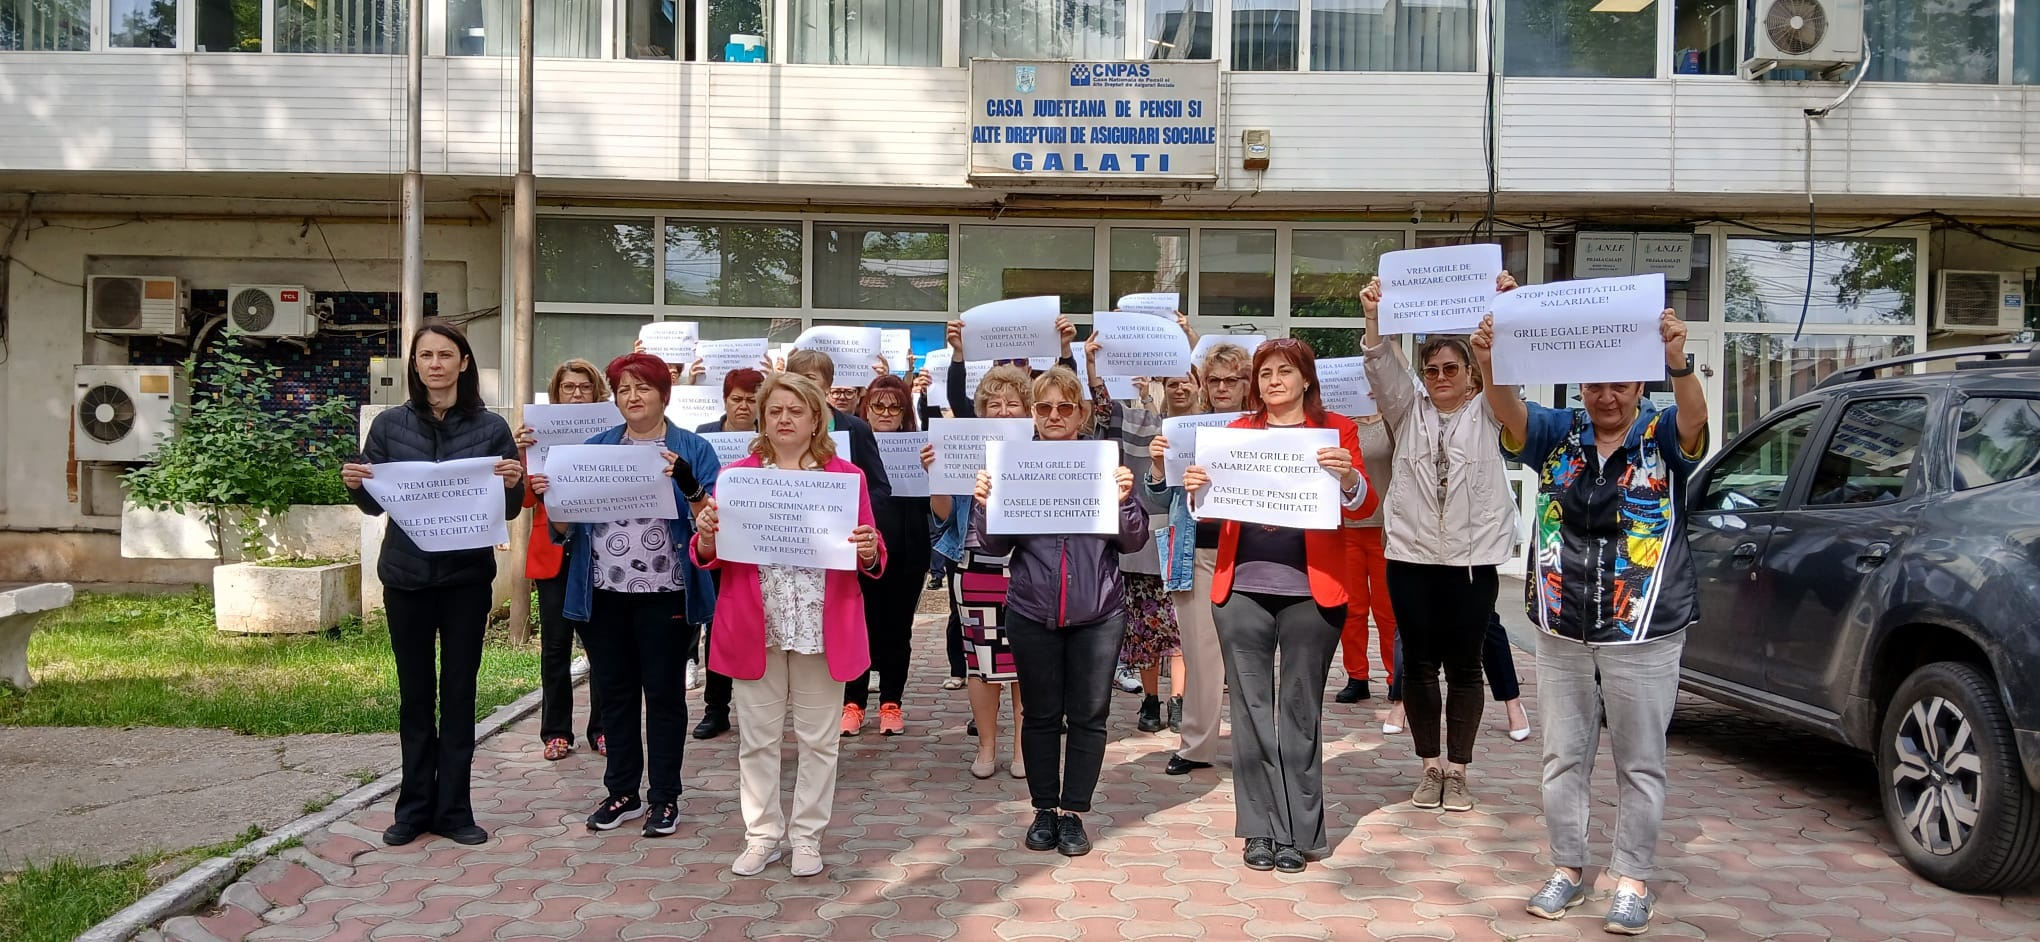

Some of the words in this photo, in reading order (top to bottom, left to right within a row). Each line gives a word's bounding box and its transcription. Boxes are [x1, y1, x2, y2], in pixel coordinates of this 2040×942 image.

[1093, 64, 1150, 76] CNPAS
[986, 99, 1024, 118] CASA
[1033, 99, 1106, 118] JUDETEANA
[1116, 100, 1132, 118] DE
[1140, 100, 1182, 118] PENSII
[1188, 100, 1202, 118] SI
[972, 126, 1001, 144] ALTE
[1006, 127, 1066, 144] DREPTURI
[1070, 127, 1086, 144] DE
[1090, 127, 1160, 144] ASIGURARI
[1163, 127, 1215, 144] SOCIALE
[1012, 153, 1170, 172] GALATI
[1392, 276, 1443, 287] SALARIZARE
[1445, 273, 1487, 282] CORECTE!
[1547, 284, 1636, 297] INECHITATILOR
[1541, 296, 1608, 307] SALARIALE!
[1394, 311, 1429, 319] RESPECT
[1441, 306, 1485, 316] ECHITATE!
[1514, 328, 1548, 338] GRILE
[1551, 326, 1589, 336] EGALE
[1592, 324, 1638, 334] PENTRU
[1531, 341, 1575, 351] FUNCTII
[1580, 339, 1621, 349] EGALE!
[1230, 451, 1257, 459] VREM
[1212, 462, 1272, 472] SALARIZARE
[397, 481, 424, 490] VREM
[427, 479, 455, 488] GRILE
[762, 478, 792, 487] EGALA,
[795, 480, 847, 490] SALARIZARE
[381, 492, 440, 502] SALARIZARE
[442, 488, 488, 498] CORECTE!
[1214, 486, 1249, 495] CASELE
[1267, 490, 1296, 499] PENSII
[613, 502, 658, 511] ECHITATE!
[759, 501, 825, 512] DISCRIMINAREA
[1214, 497, 1253, 506] RESPECT
[1268, 502, 1317, 512] ECHITATE!
[424, 517, 436, 525] DE
[439, 514, 467, 524] PENSII
[769, 513, 802, 521] SISTEM!
[441, 525, 488, 535] ECHITATE!
[765, 524, 828, 534] INECHITATILOR
[761, 534, 810, 543] SALARIALE!
[780, 547, 816, 555] RESPECT!
